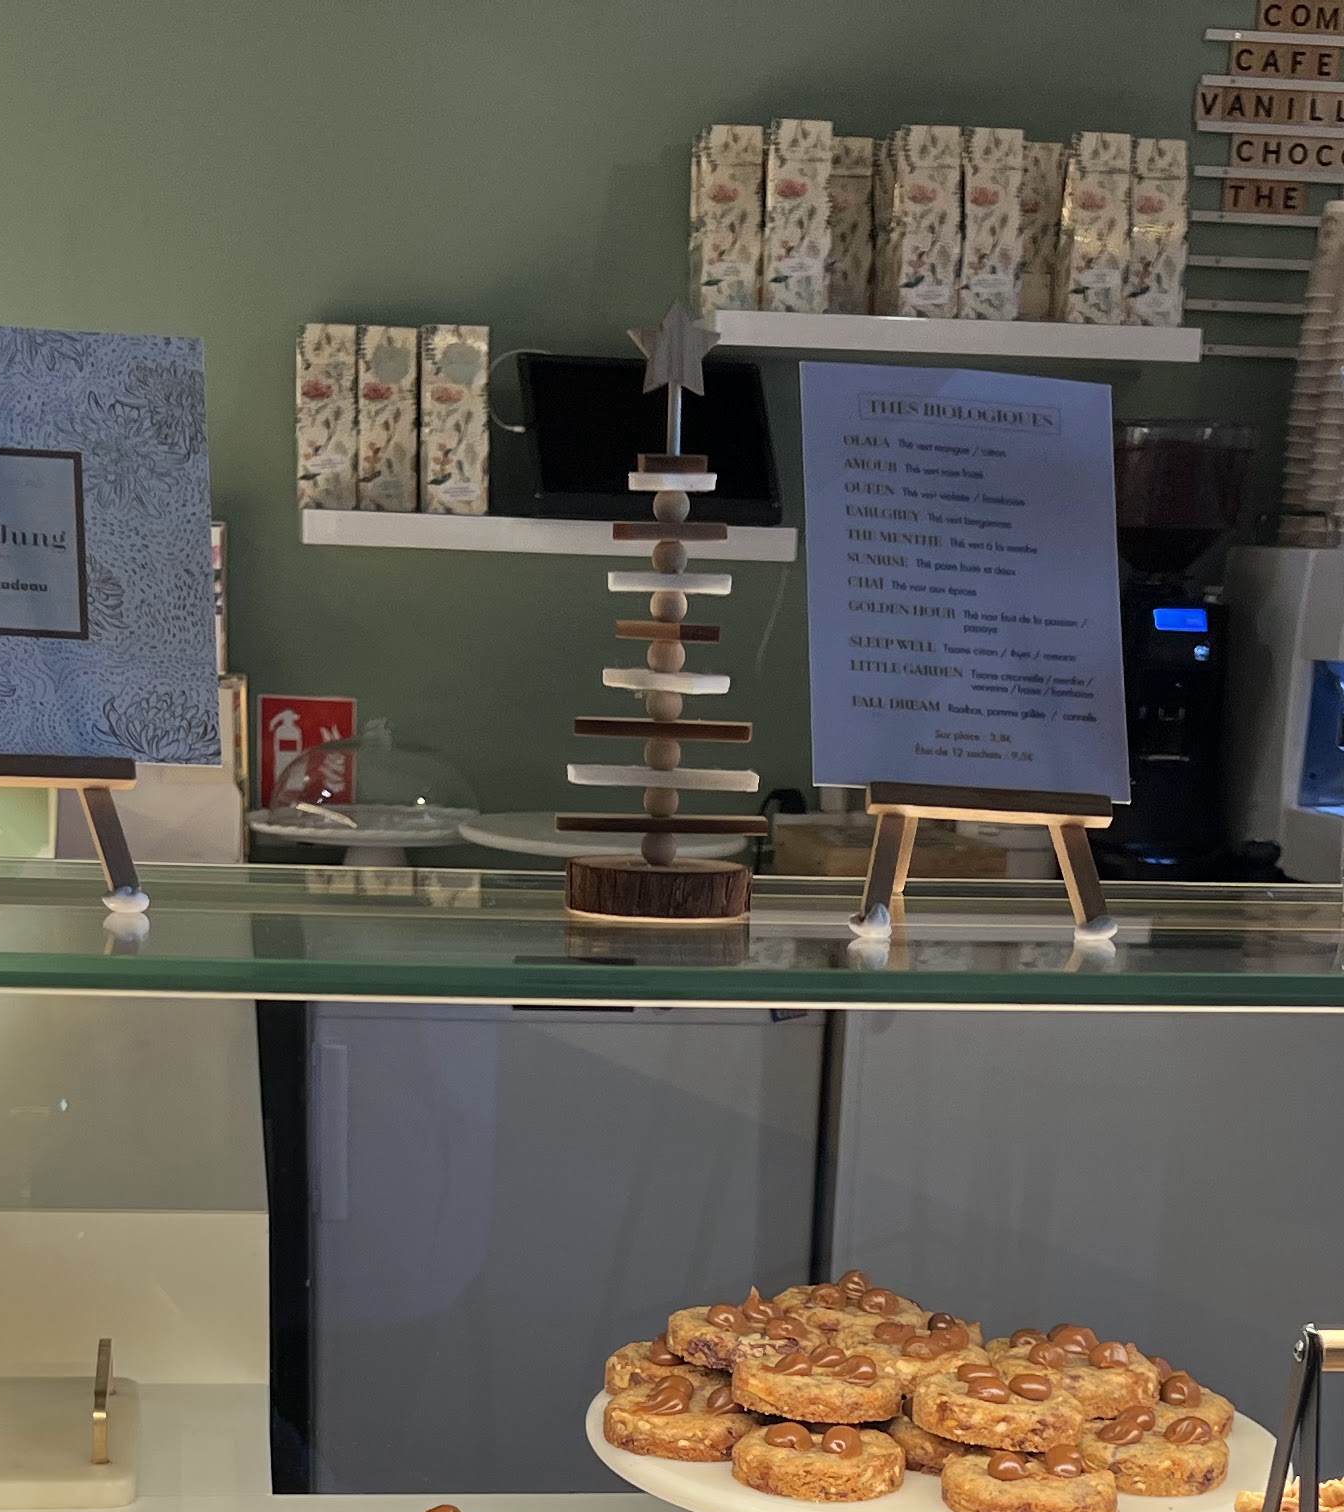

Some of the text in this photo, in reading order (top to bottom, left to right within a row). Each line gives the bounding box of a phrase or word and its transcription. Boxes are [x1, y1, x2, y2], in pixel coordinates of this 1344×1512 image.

[1235, 49, 1332, 77] CAFE
[1228, 185, 1299, 210] THE
[848, 600, 909, 615] GOLDEN
[849, 659, 901, 675] LITTLE
